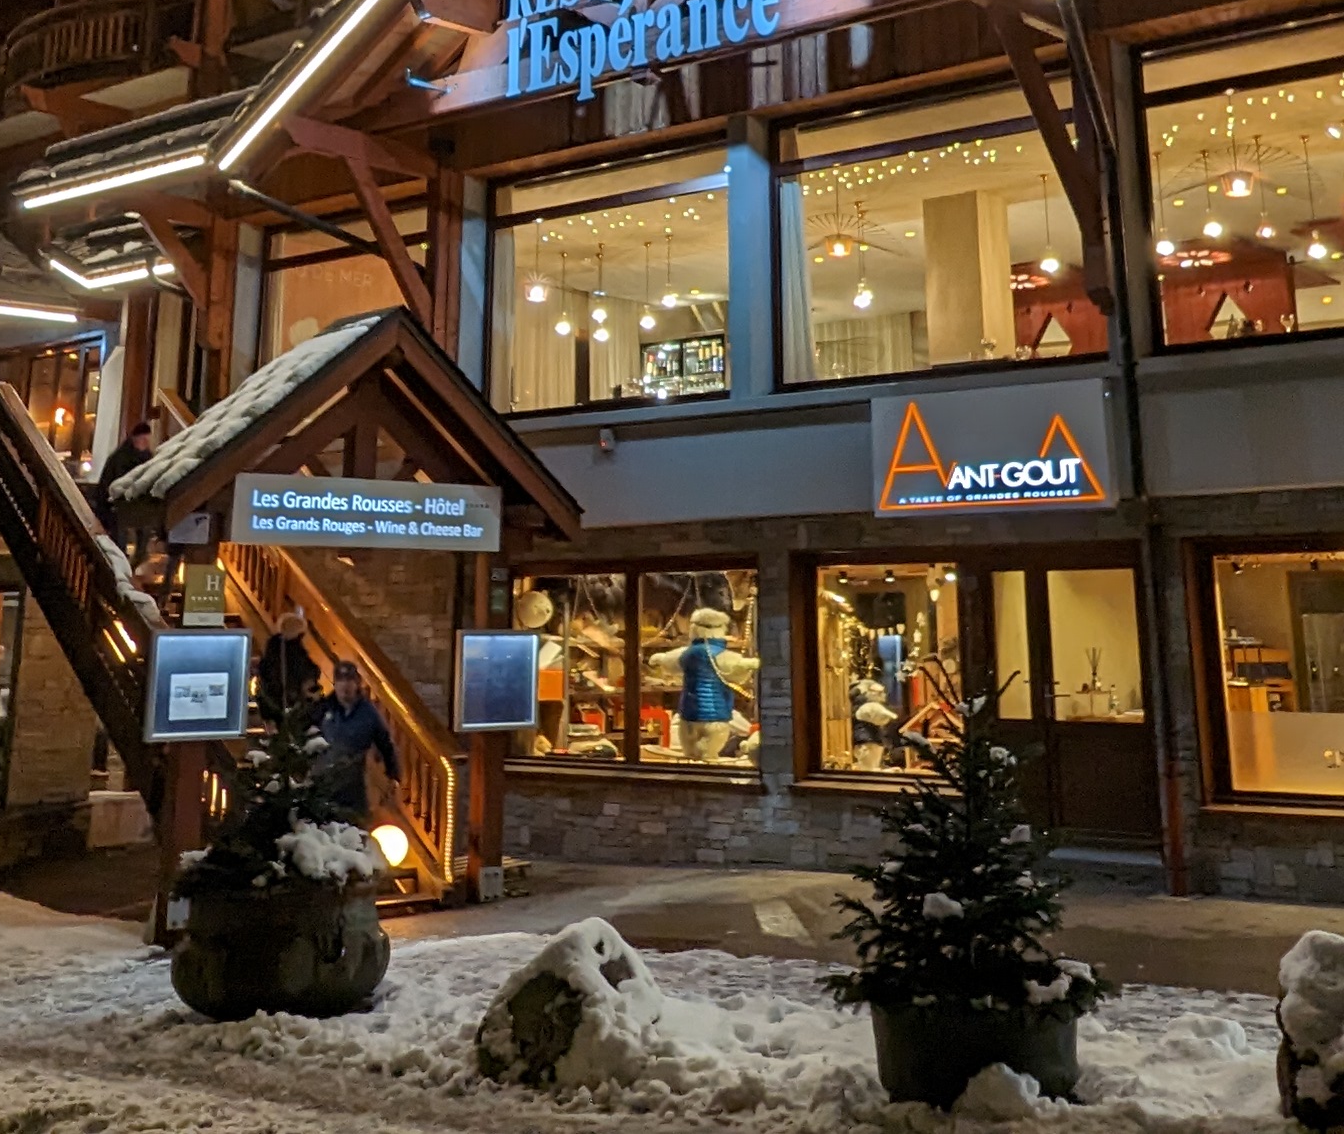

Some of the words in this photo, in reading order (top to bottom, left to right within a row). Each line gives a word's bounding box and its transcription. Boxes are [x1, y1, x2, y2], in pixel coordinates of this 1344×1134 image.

[252, 489, 279, 508] Les
[282, 491, 348, 512] Grandes
[351, 494, 413, 514] Rousses
[423, 497, 466, 516] Hôtel
[898, 497, 907, 505] A
[909, 495, 944, 504] TASTE
[946, 494, 962, 502] OF
[965, 492, 1020, 502] GRANDES
[1023, 489, 1081, 498] ROUSSES
[252, 515, 273, 530] Les
[275, 516, 320, 532] Grands
[322, 518, 366, 535] Rouges
[374, 521, 406, 535] Wine
[408, 521, 419, 535] &
[420, 522, 461, 538] Cheese
[463, 523, 484, 538] Bar
[206, 574, 221, 592] H
